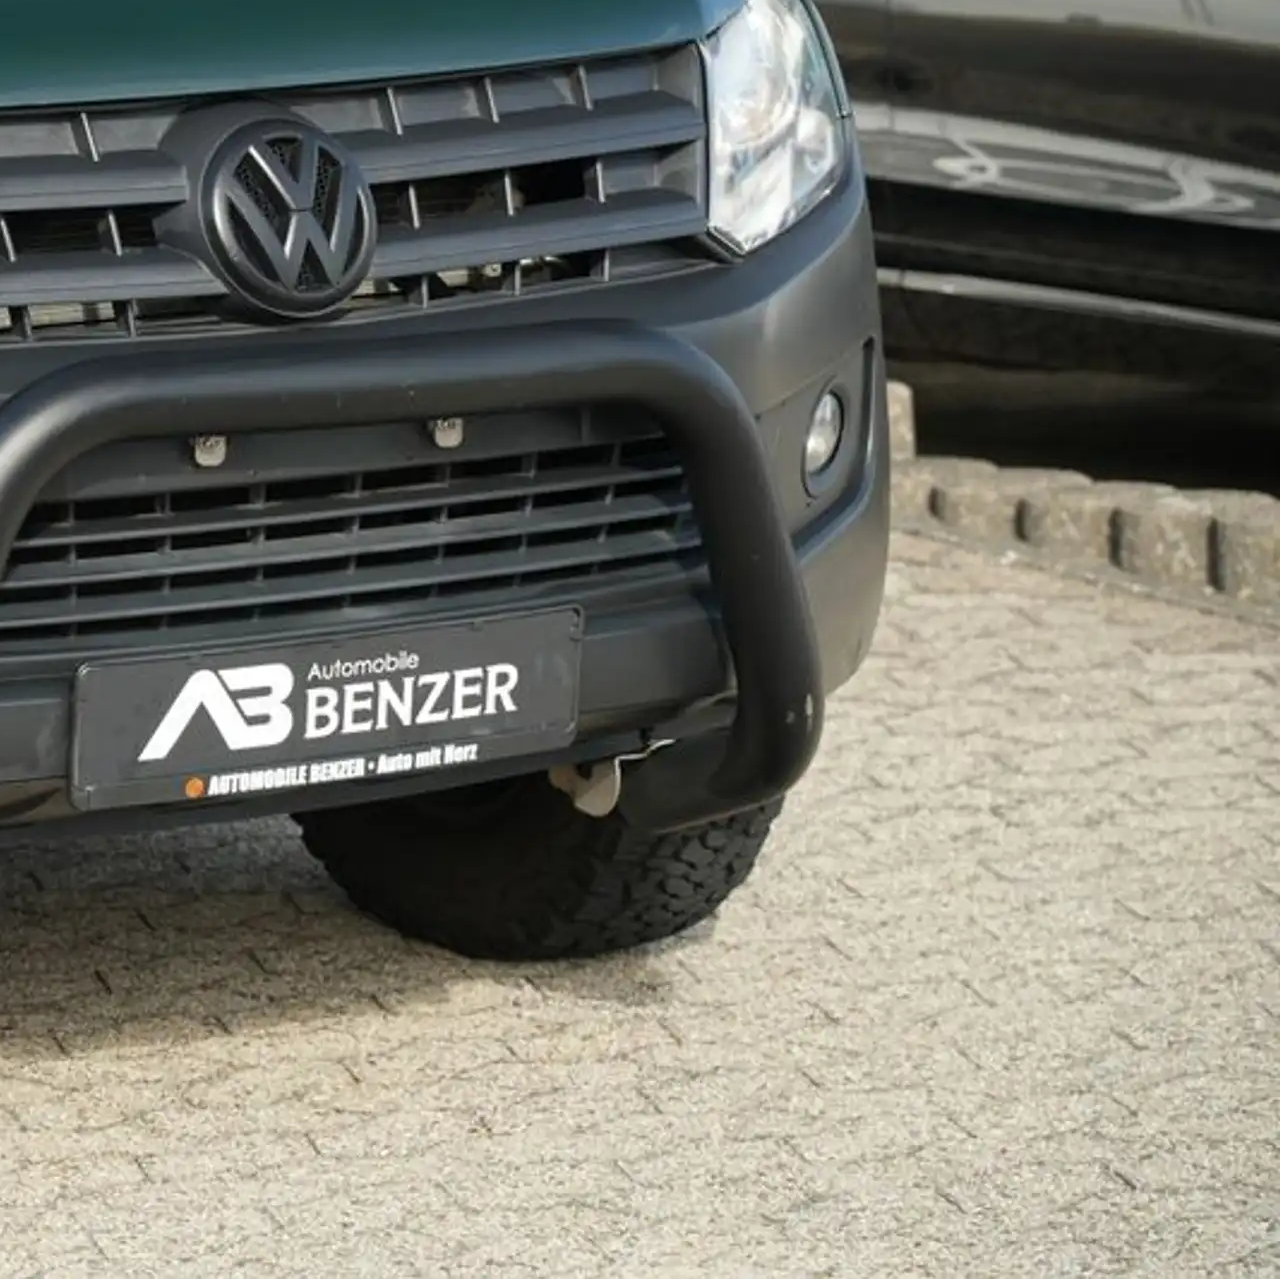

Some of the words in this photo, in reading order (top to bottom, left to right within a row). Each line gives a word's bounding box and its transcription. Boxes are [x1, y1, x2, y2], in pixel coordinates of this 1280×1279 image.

[307, 650, 420, 682] Automobile
[303, 663, 519, 740] BENZER
[207, 765, 308, 797] AUTOMOBILE
[309, 758, 366, 785] BENZER
[376, 752, 413, 775] Auto
[415, 746, 442, 769] mit
